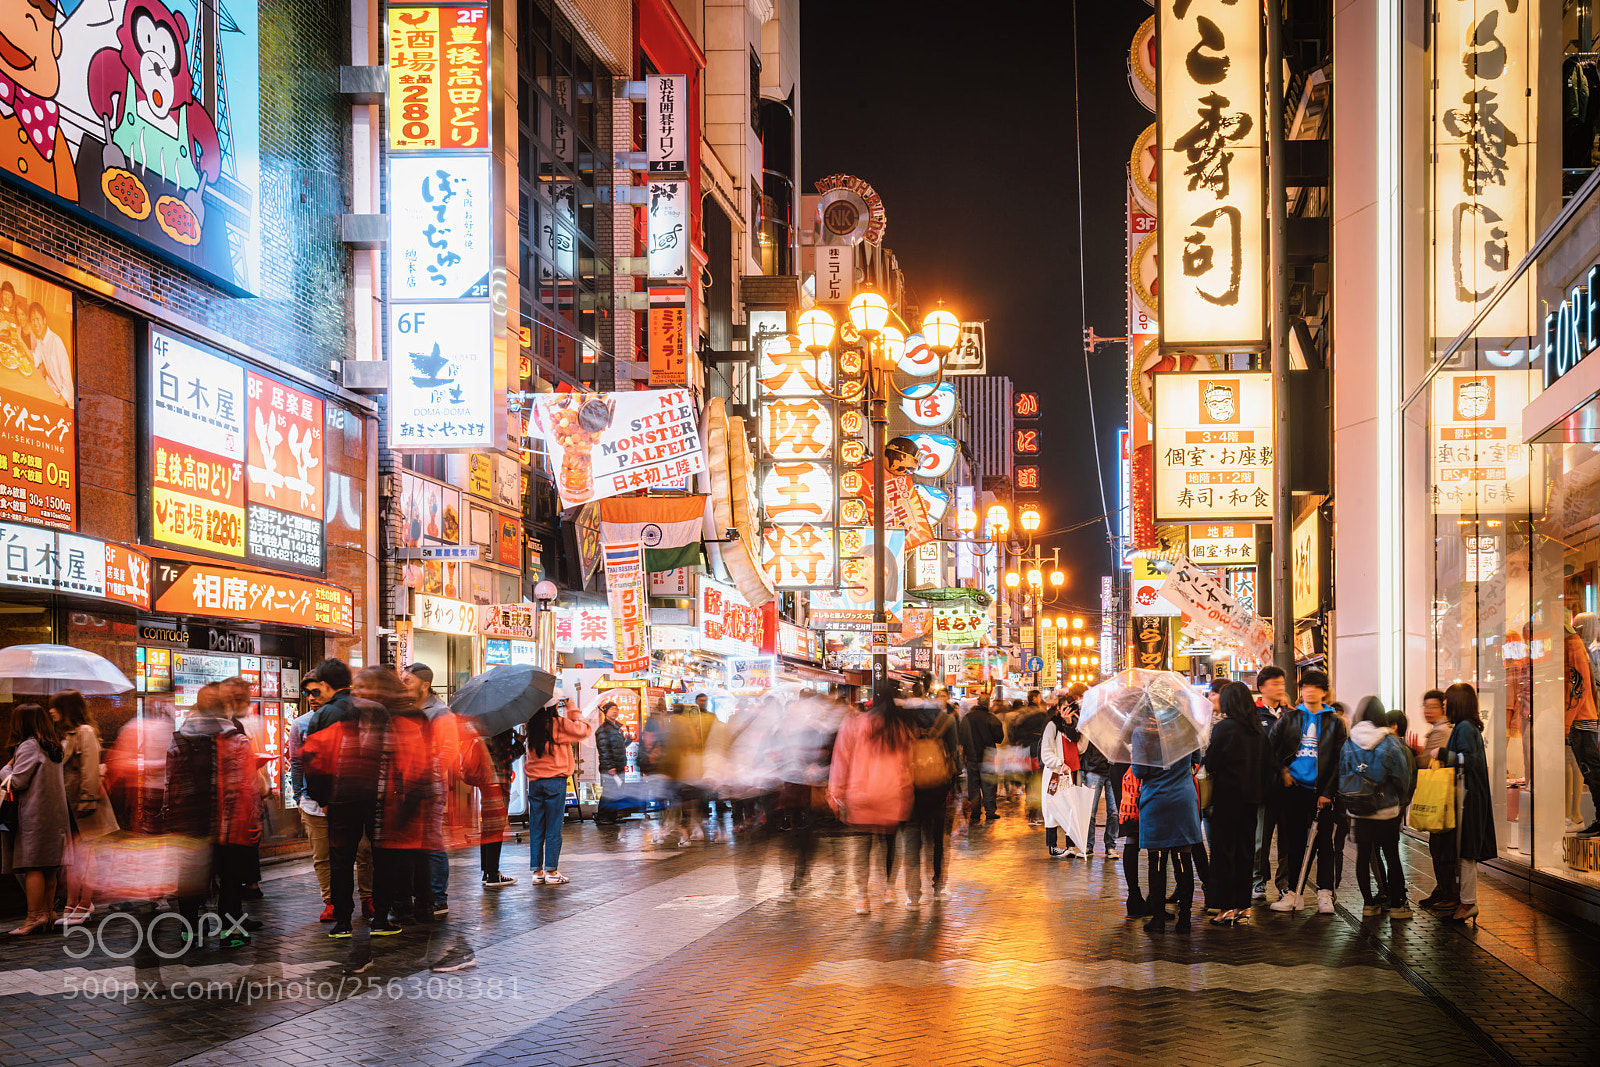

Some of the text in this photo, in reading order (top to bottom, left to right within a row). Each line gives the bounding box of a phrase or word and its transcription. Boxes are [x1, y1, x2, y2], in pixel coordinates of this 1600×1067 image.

[457, 10, 484, 23] 2F
[391, 29, 438, 72] 酒場
[446, 25, 483, 146] 豊後高田どり
[402, 85, 429, 139] 280
[659, 78, 675, 160] 浪花囲碁サロン
[831, 208, 852, 227] NK
[471, 285, 488, 296] 2F
[397, 312, 425, 334] 6F
[153, 336, 169, 357] 4F
[661, 309, 675, 370] ミティラー
[160, 362, 236, 422] 白木屋
[247, 377, 263, 400] 8F
[659, 390, 686, 408] NY
[271, 387, 313, 421] 居楽屋
[630, 405, 692, 432] STYLE
[36, 440, 65, 454] DINING
[601, 421, 695, 457] MONSTER
[12, 450, 43, 470] 飲み放題
[616, 435, 697, 468] PALFEIT
[757, 335, 834, 586] 大阪王将
[1164, 446, 1273, 467] 個室・お座敷
[12, 466, 43, 484] 食べ放題
[46, 462, 70, 489] 0円
[154, 447, 232, 499] 豊後高田どり
[0, 483, 27, 500] 飲み放題
[1176, 486, 1270, 509] 寿司・和食
[0, 497, 27, 514] 食べ放題
[28, 493, 71, 513] 30分 1500円
[169, 498, 204, 541] 酒場
[212, 510, 238, 547] 280
[1207, 526, 1235, 538] 地階
[6, 533, 87, 580] 白木屋
[105, 545, 116, 563] 8F
[250, 543, 265, 556] TEL
[1191, 543, 1252, 558] 個室・和食
[106, 566, 125, 582] 居楽屋
[159, 565, 178, 582] 7F
[192, 573, 313, 616] 相席ダイニング
[423, 599, 454, 625] 串かつ
[143, 626, 190, 643] comrade
[580, 611, 608, 642] 薬
[936, 616, 982, 632] ぼらや
[151, 651, 166, 663] 3F
[246, 658, 255, 669] 7F
[1562, 836, 1580, 866] SHOP
